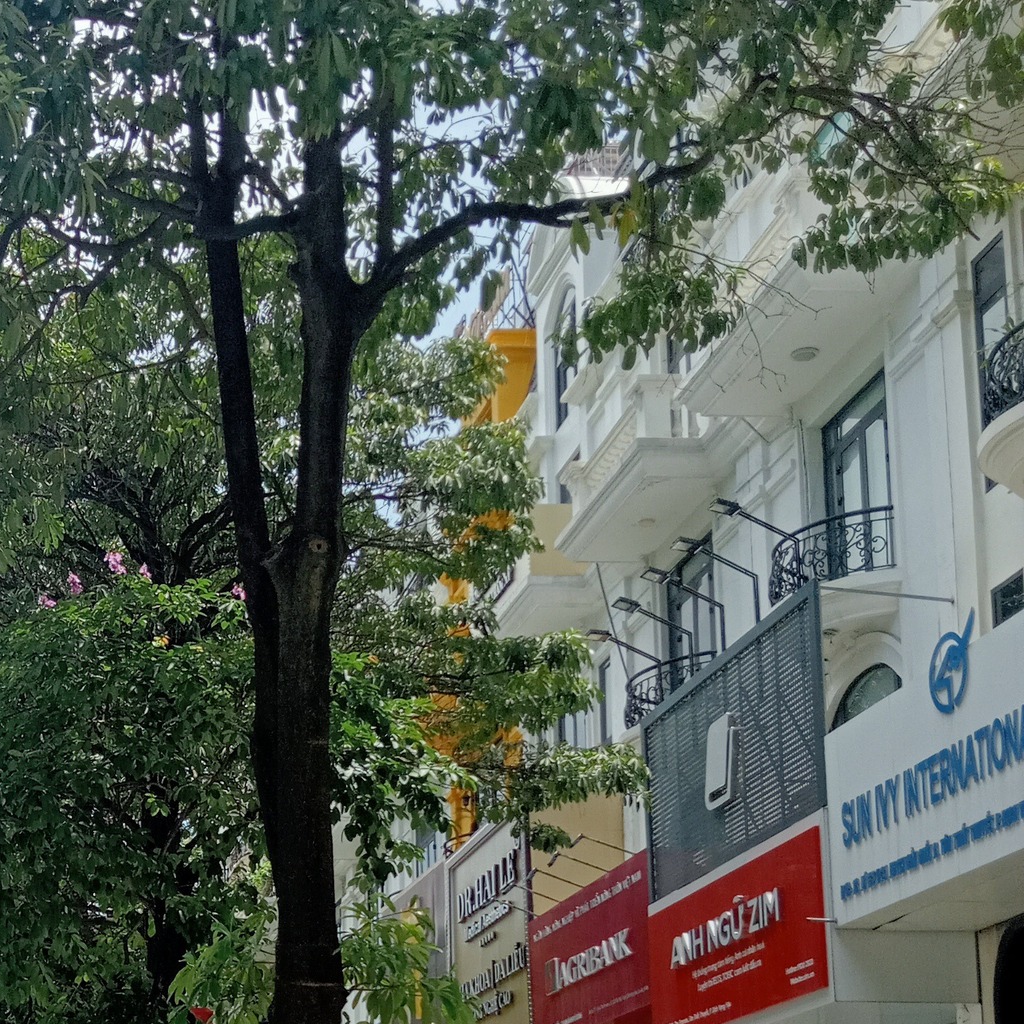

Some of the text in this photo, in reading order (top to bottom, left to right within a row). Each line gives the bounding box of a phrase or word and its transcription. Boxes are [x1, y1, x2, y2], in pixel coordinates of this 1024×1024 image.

[841, 789, 872, 849] SUN
[875, 774, 900, 833] IVY
[559, 927, 632, 988] AGRIBANK
[670, 923, 705, 970] ANH
[747, 887, 780, 934] ZIM
